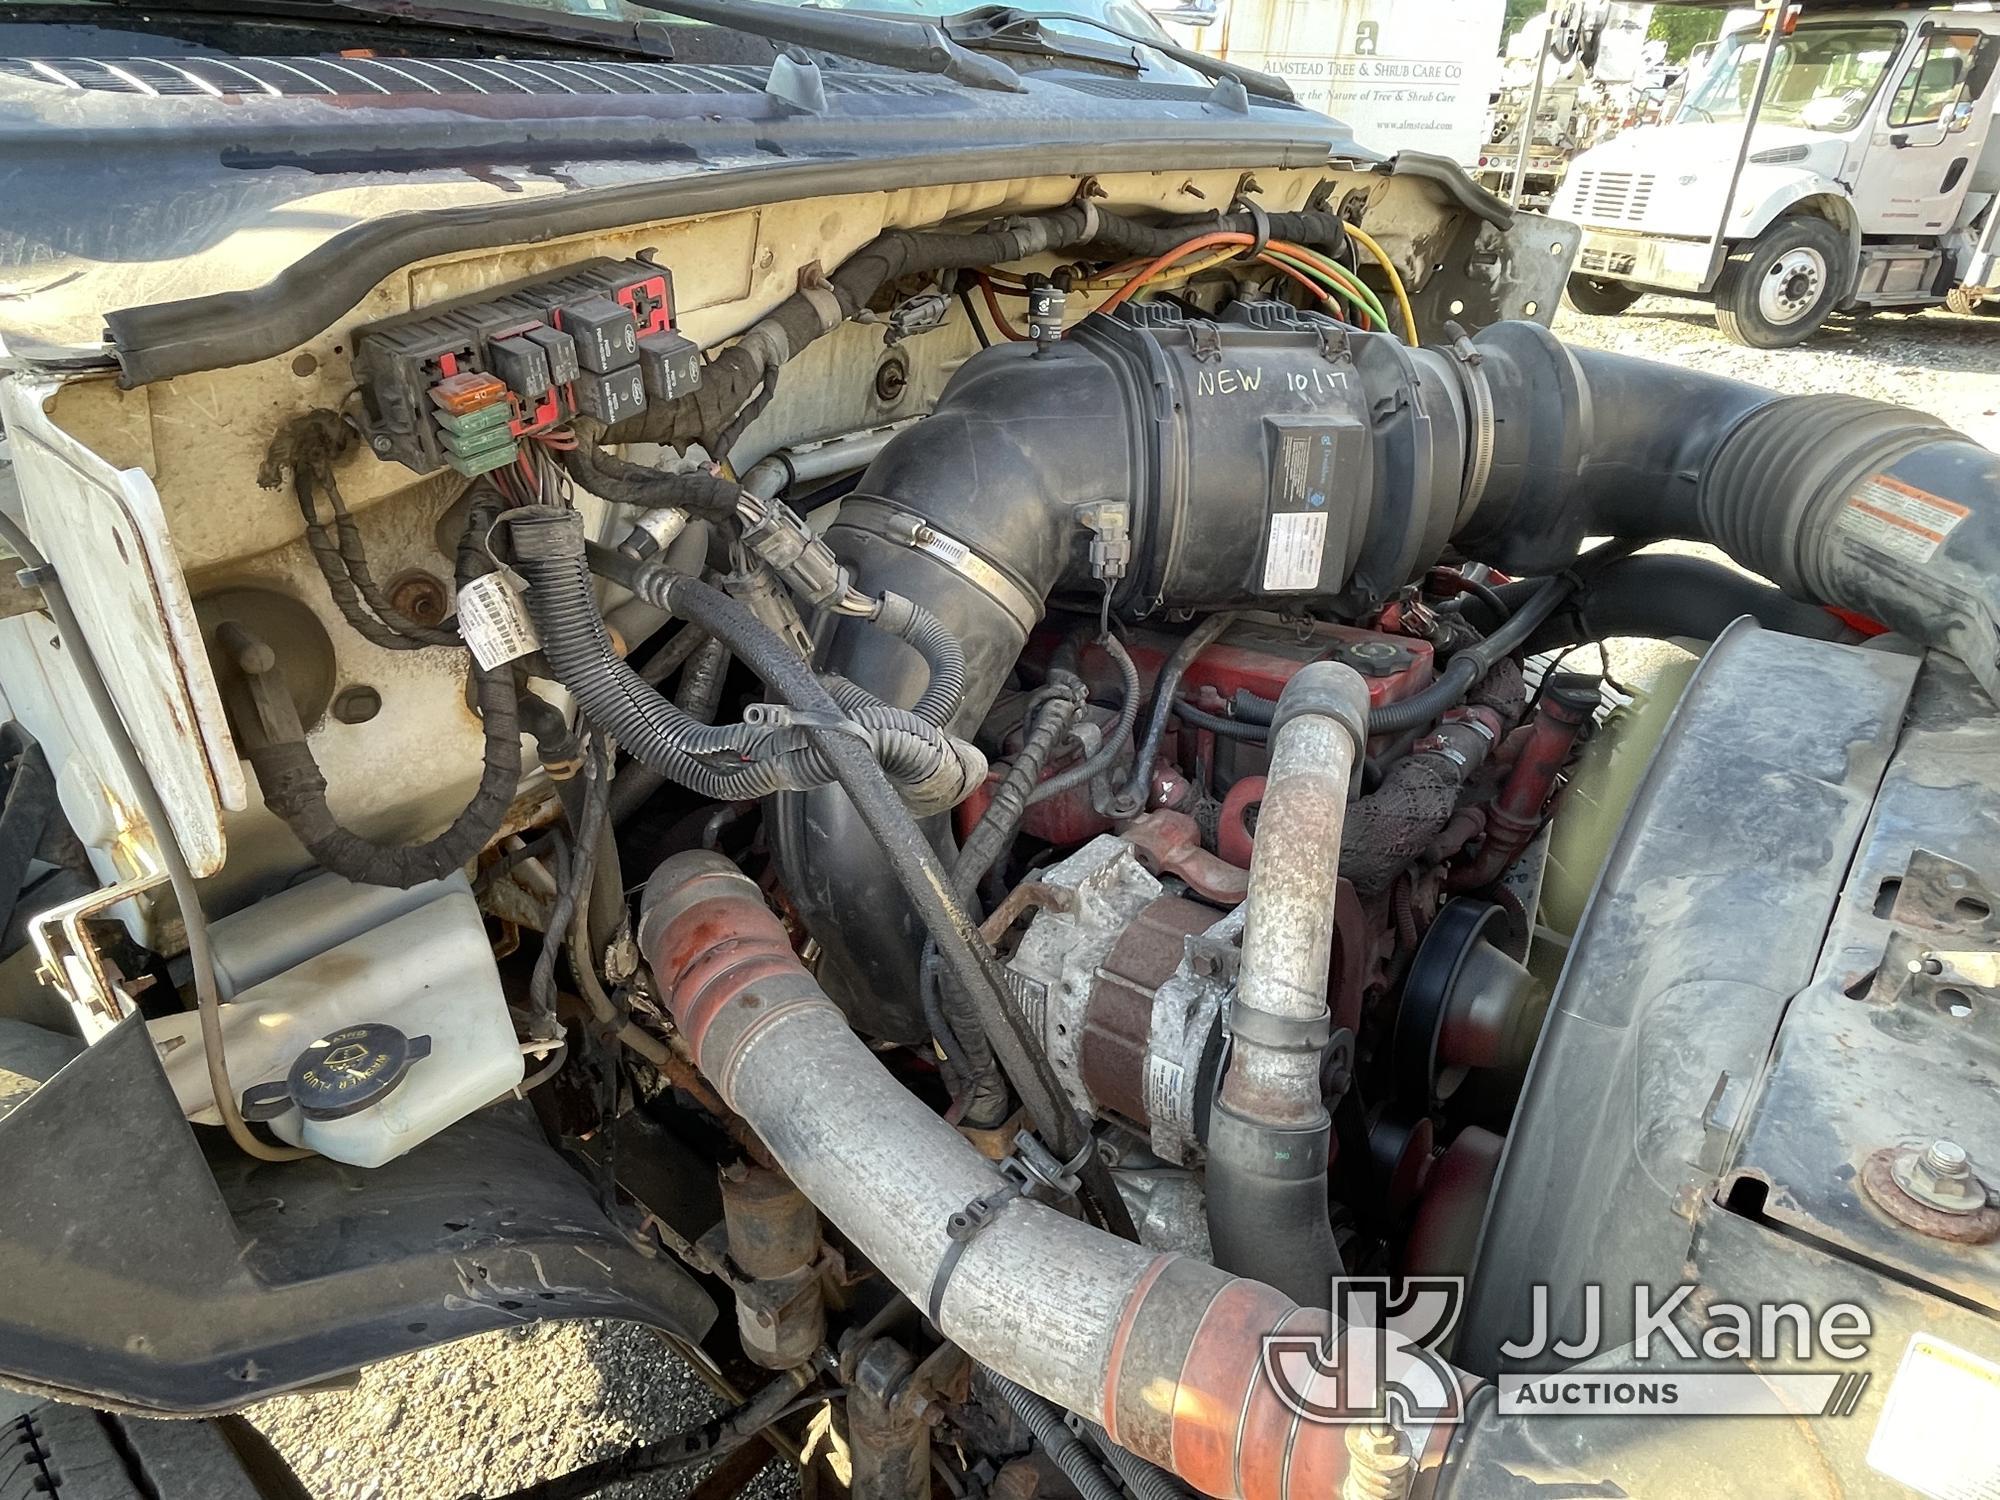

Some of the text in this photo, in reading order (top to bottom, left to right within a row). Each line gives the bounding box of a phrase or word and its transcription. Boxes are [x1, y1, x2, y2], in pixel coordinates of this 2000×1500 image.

[1328, 62, 1356, 76] TREE
[1359, 62, 1369, 76] &
[1374, 62, 1409, 77] SHRUB
[1412, 64, 1441, 78] CARE
[1328, 90, 1357, 101] Nature
[1360, 89, 1371, 101] of
[1373, 90, 1392, 101] Tree
[1394, 90, 1404, 102] &
[1407, 91, 1433, 102] Shrub
[1436, 92, 1456, 102] Care
[1377, 120, 1453, 130] www.almstead.com
[1198, 367, 1348, 396] NEW 10/17
